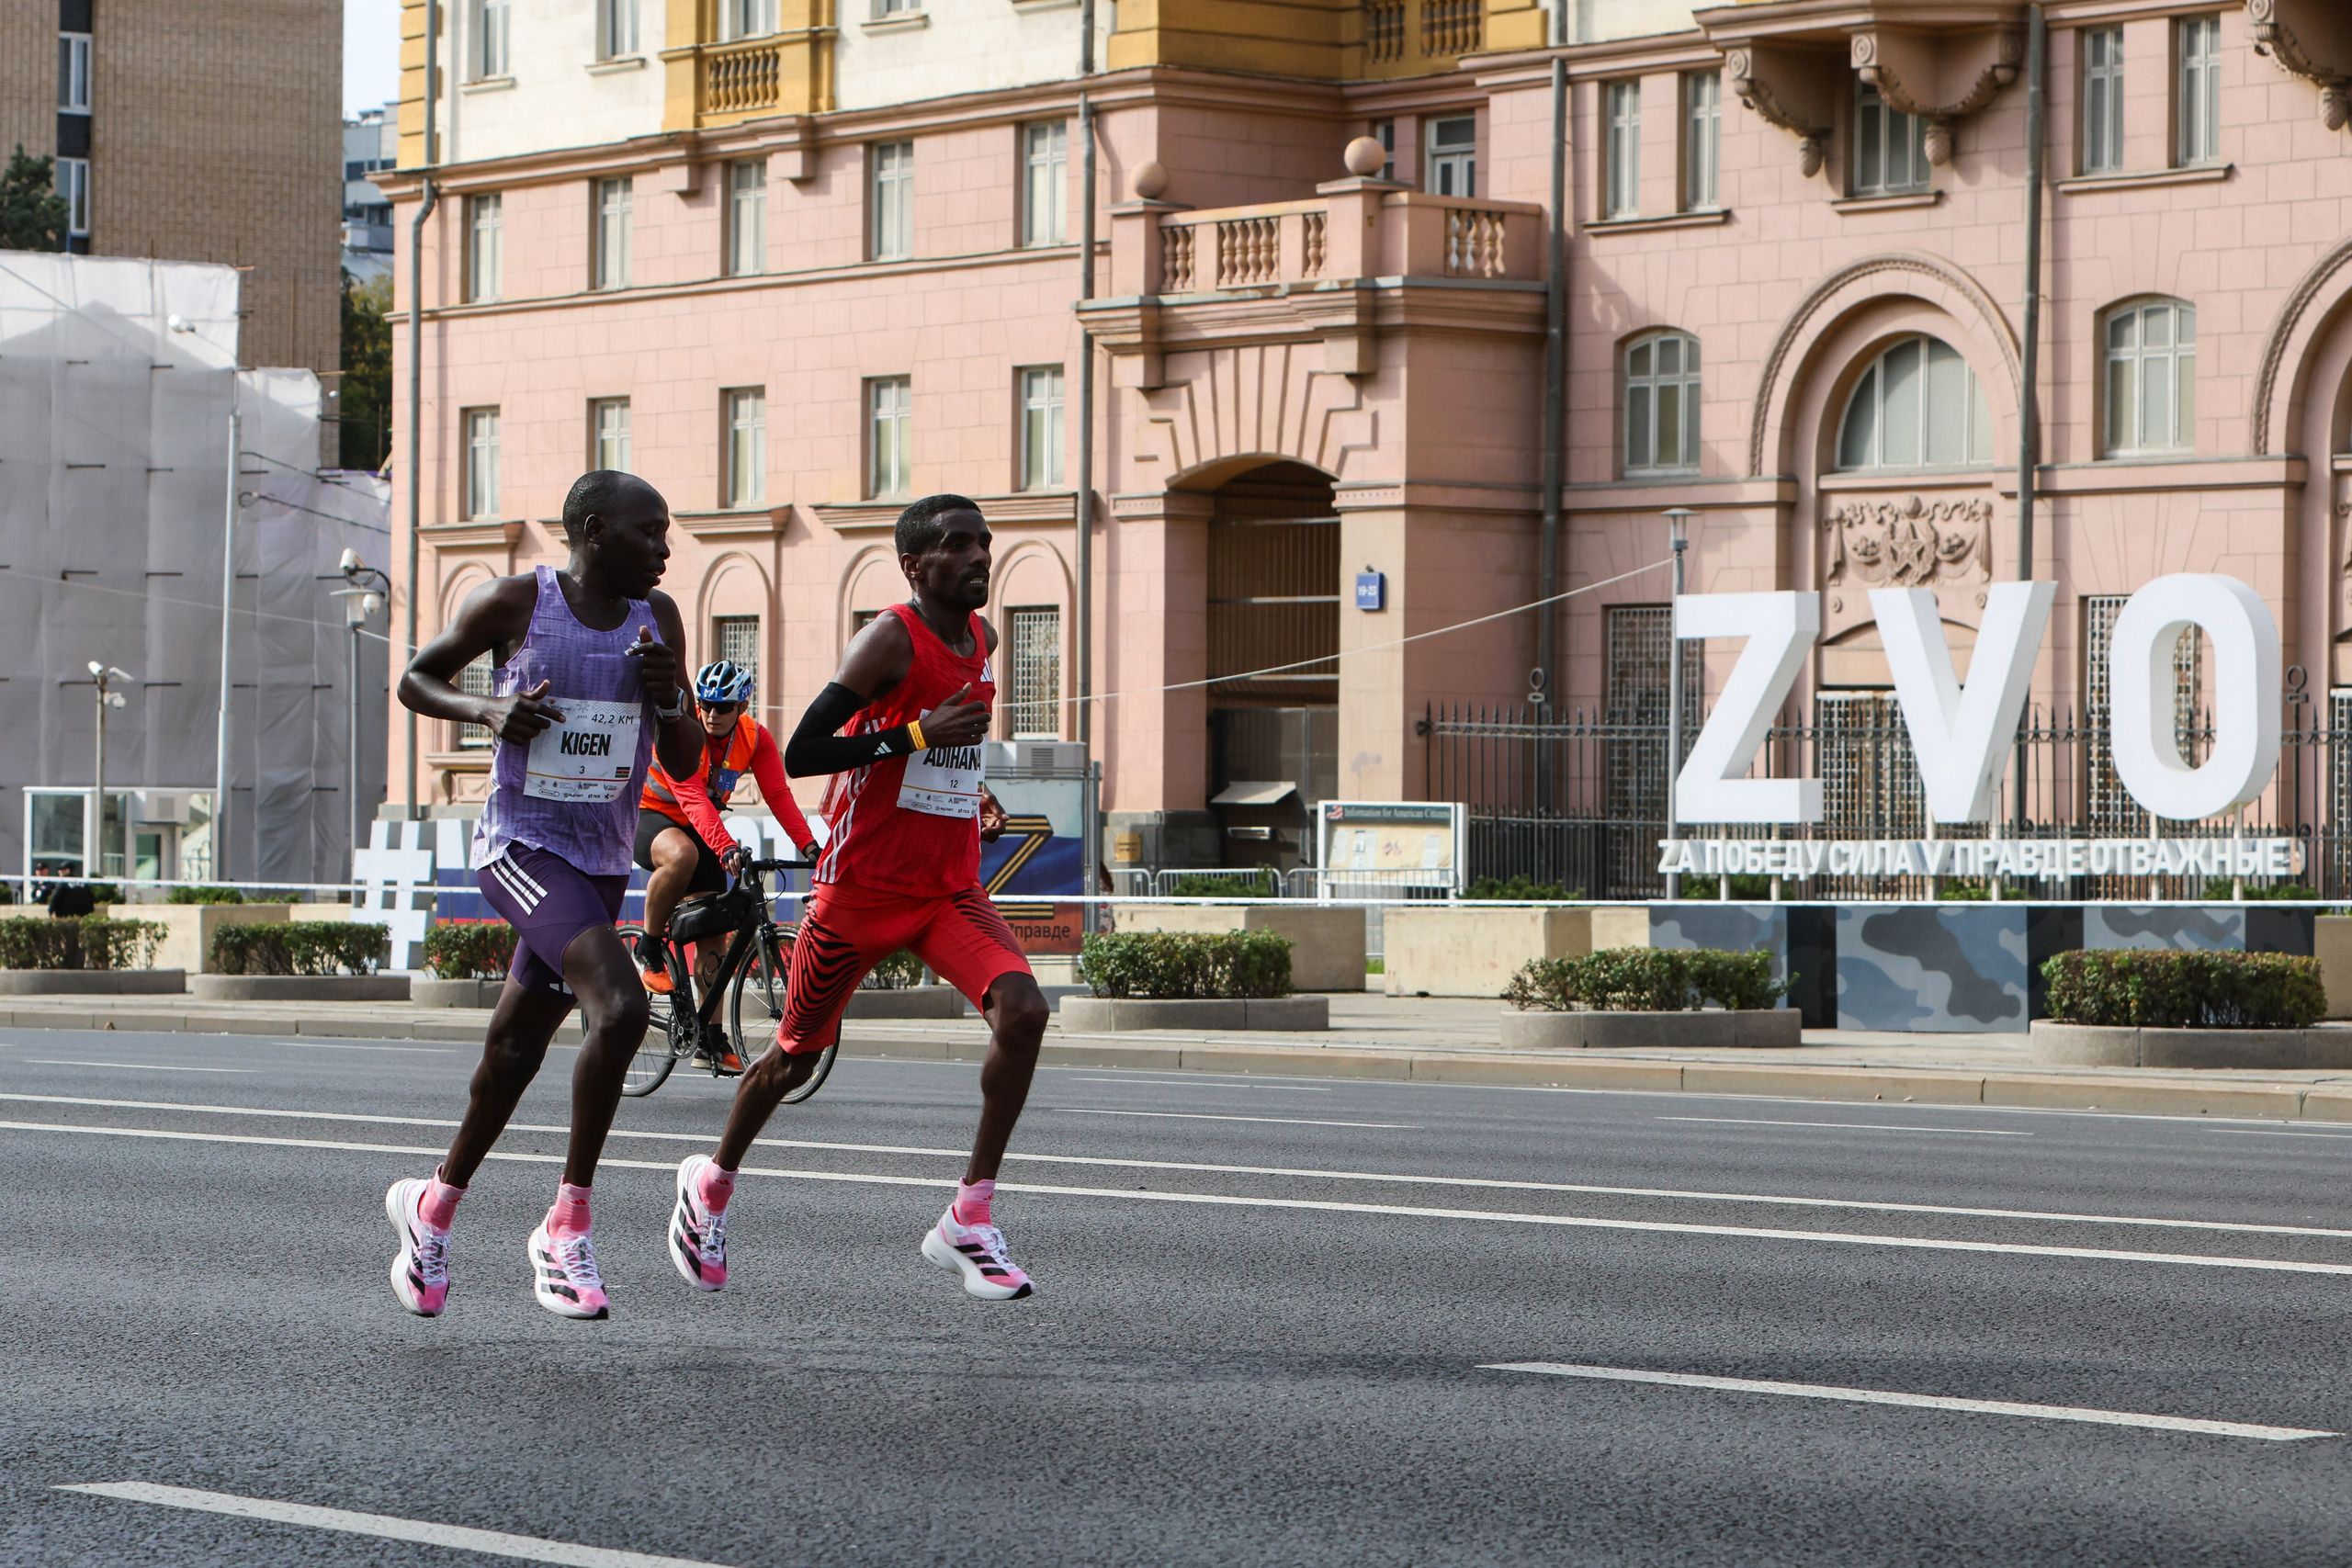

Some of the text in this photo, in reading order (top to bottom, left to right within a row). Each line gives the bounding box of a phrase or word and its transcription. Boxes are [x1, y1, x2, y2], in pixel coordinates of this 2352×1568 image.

[591, 714, 615, 725] 42,2
[560, 731, 612, 756] KIGEN
[579, 766, 585, 774] 3
[950, 779, 958, 789] 12
[1344, 807, 1381, 818] Information
[1383, 808, 1392, 818] for
[1394, 808, 1423, 818] American
[1704, 840, 1826, 881] ПОБЕДУ
[1828, 840, 1914, 875] СИЛА
[1954, 840, 2086, 883] ПРАВДЕ
[2088, 840, 2289, 876] ОТВАЖНЫЕ
